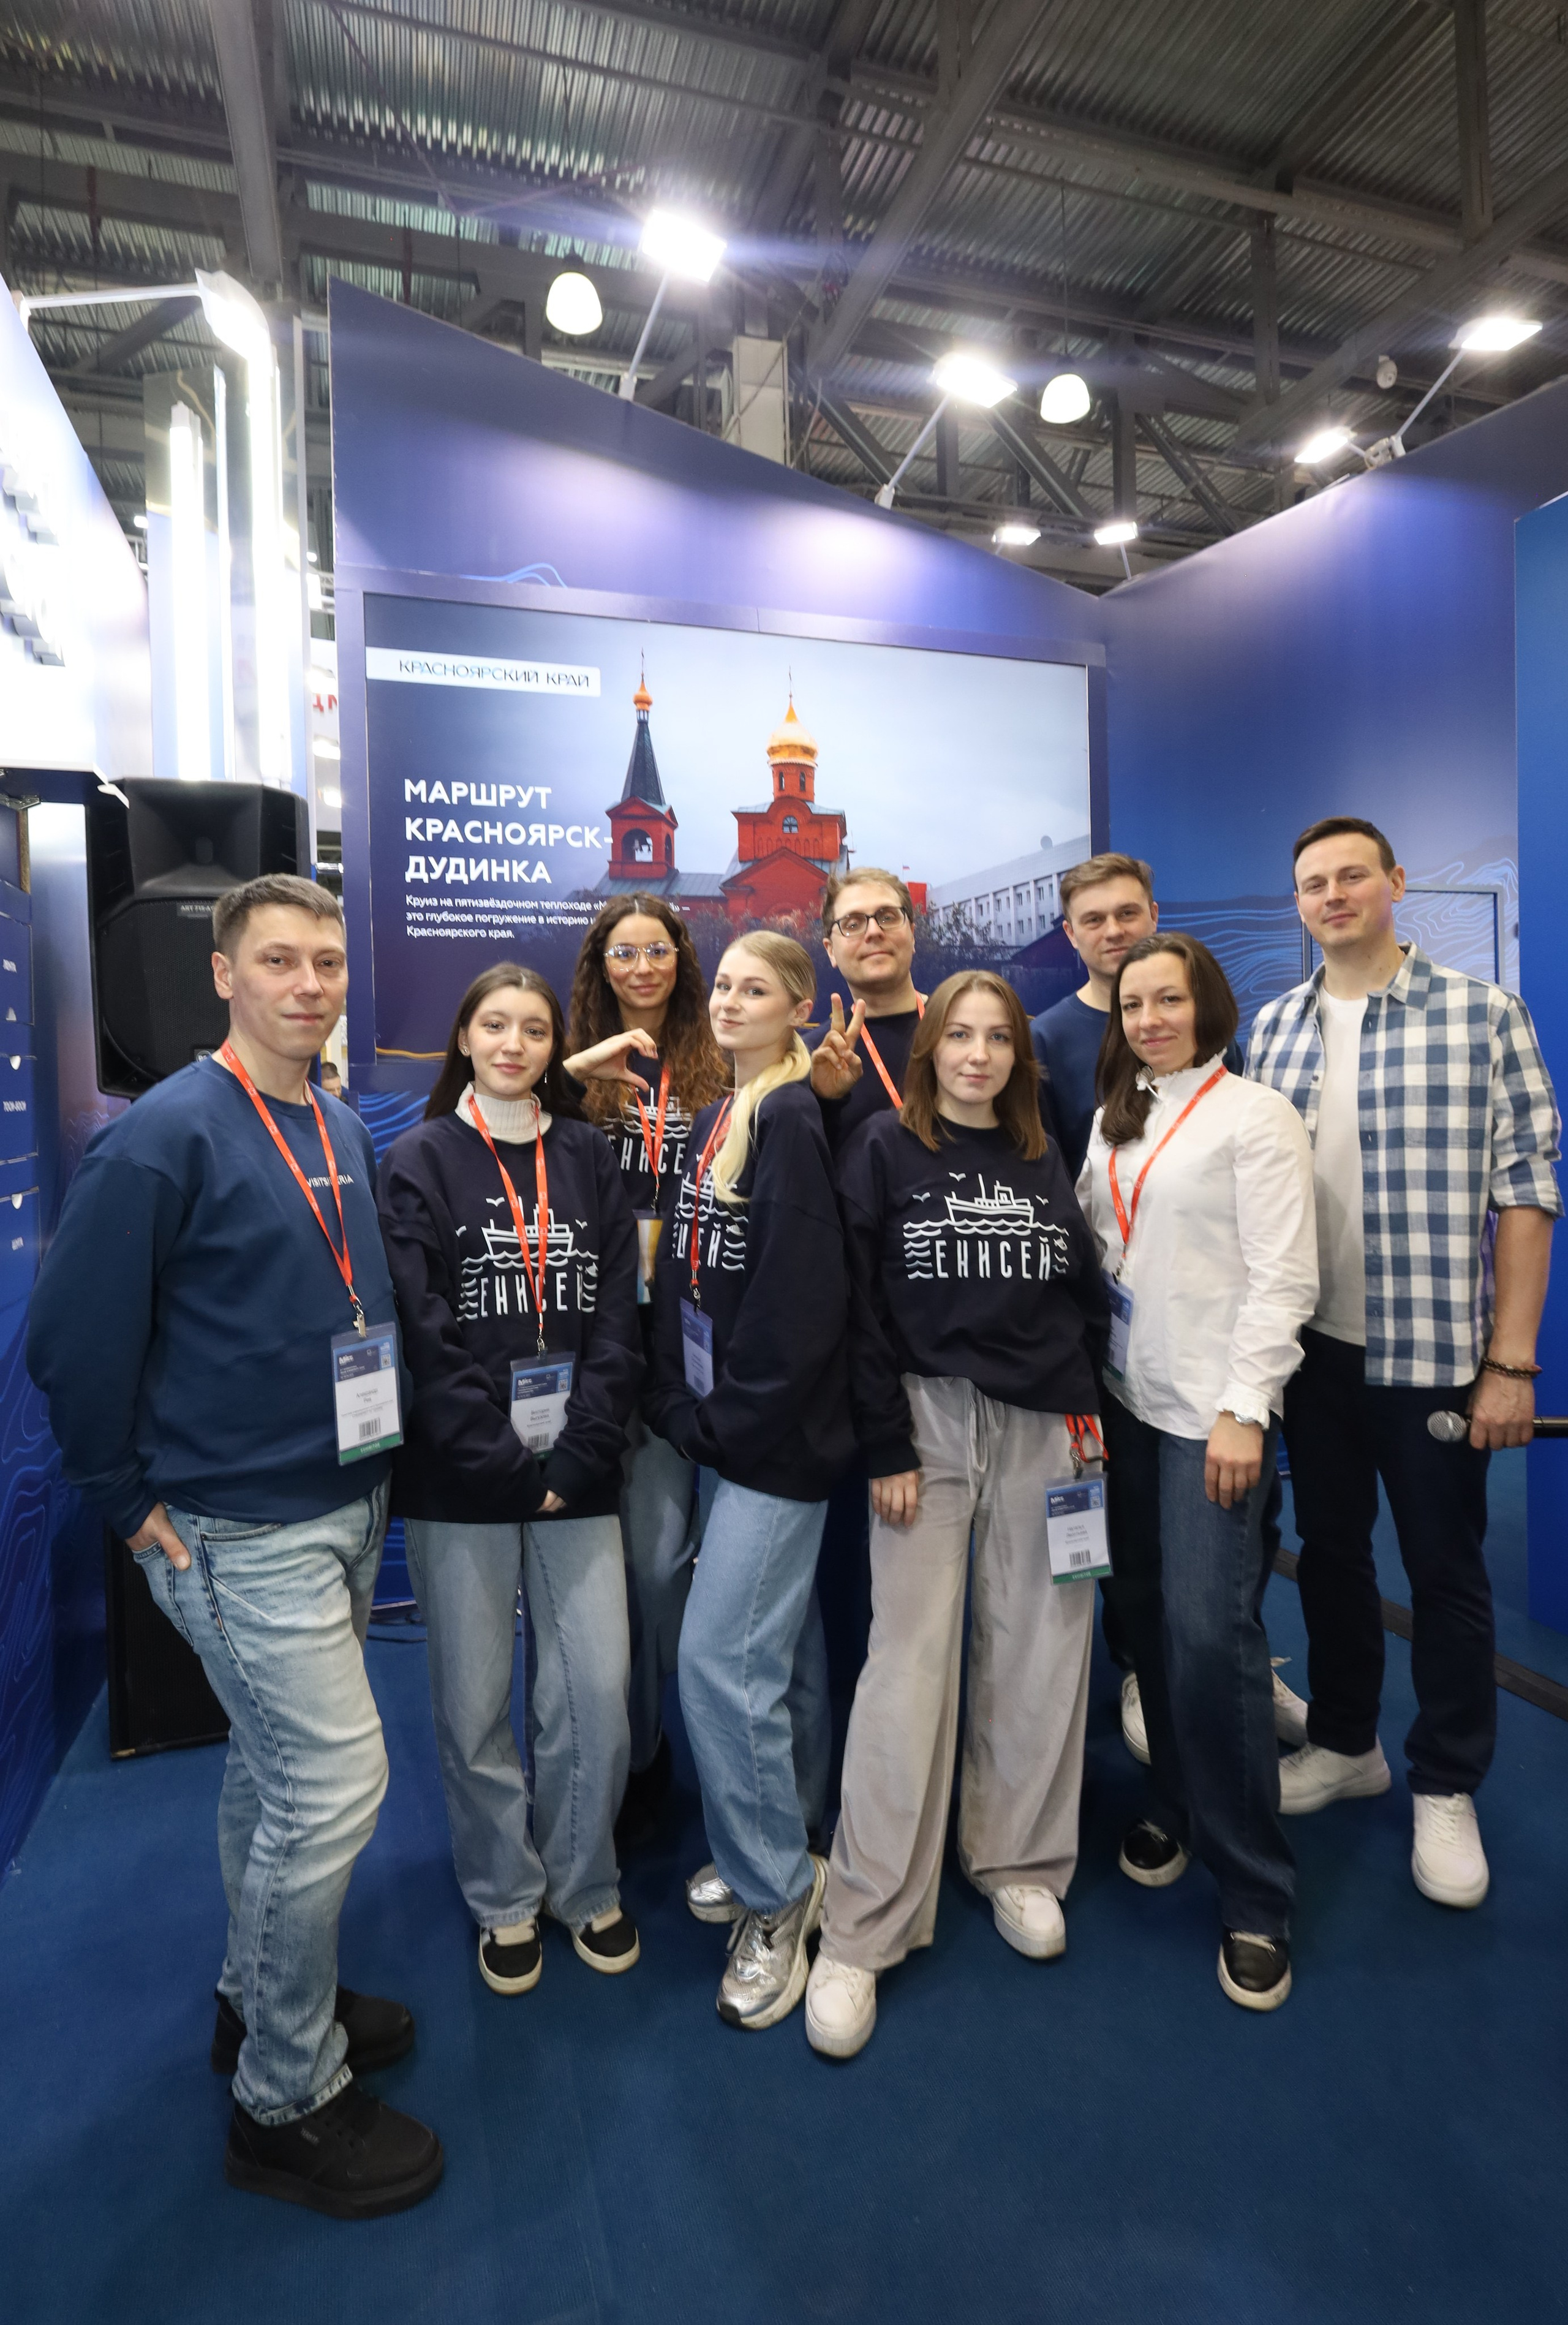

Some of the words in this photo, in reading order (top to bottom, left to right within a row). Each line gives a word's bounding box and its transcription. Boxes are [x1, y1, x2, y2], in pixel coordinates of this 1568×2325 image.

[399, 660, 538, 684] КРАСНОЯРСКИЙ
[546, 671, 589, 687] КРАЙ
[404, 778, 552, 809] МАРШРУТ
[405, 817, 614, 849] КРАСНОЯРСК-
[404, 855, 552, 885] ДУДИНКА
[405, 894, 438, 908] Круиз
[440, 898, 453, 907] на
[455, 897, 538, 910] пятизвёздочном
[540, 901, 592, 912] теплоходе
[405, 912, 424, 921] это
[425, 911, 473, 924] глубокое
[475, 913, 537, 926] погружение
[538, 915, 545, 924] в
[546, 916, 589, 926] историю
[406, 925, 487, 939] Красноярского
[488, 928, 515, 940] края.
[306, 1174, 355, 1188] VISITSIERIA
[935, 1236, 1051, 1281] ЕНИСЕЙ
